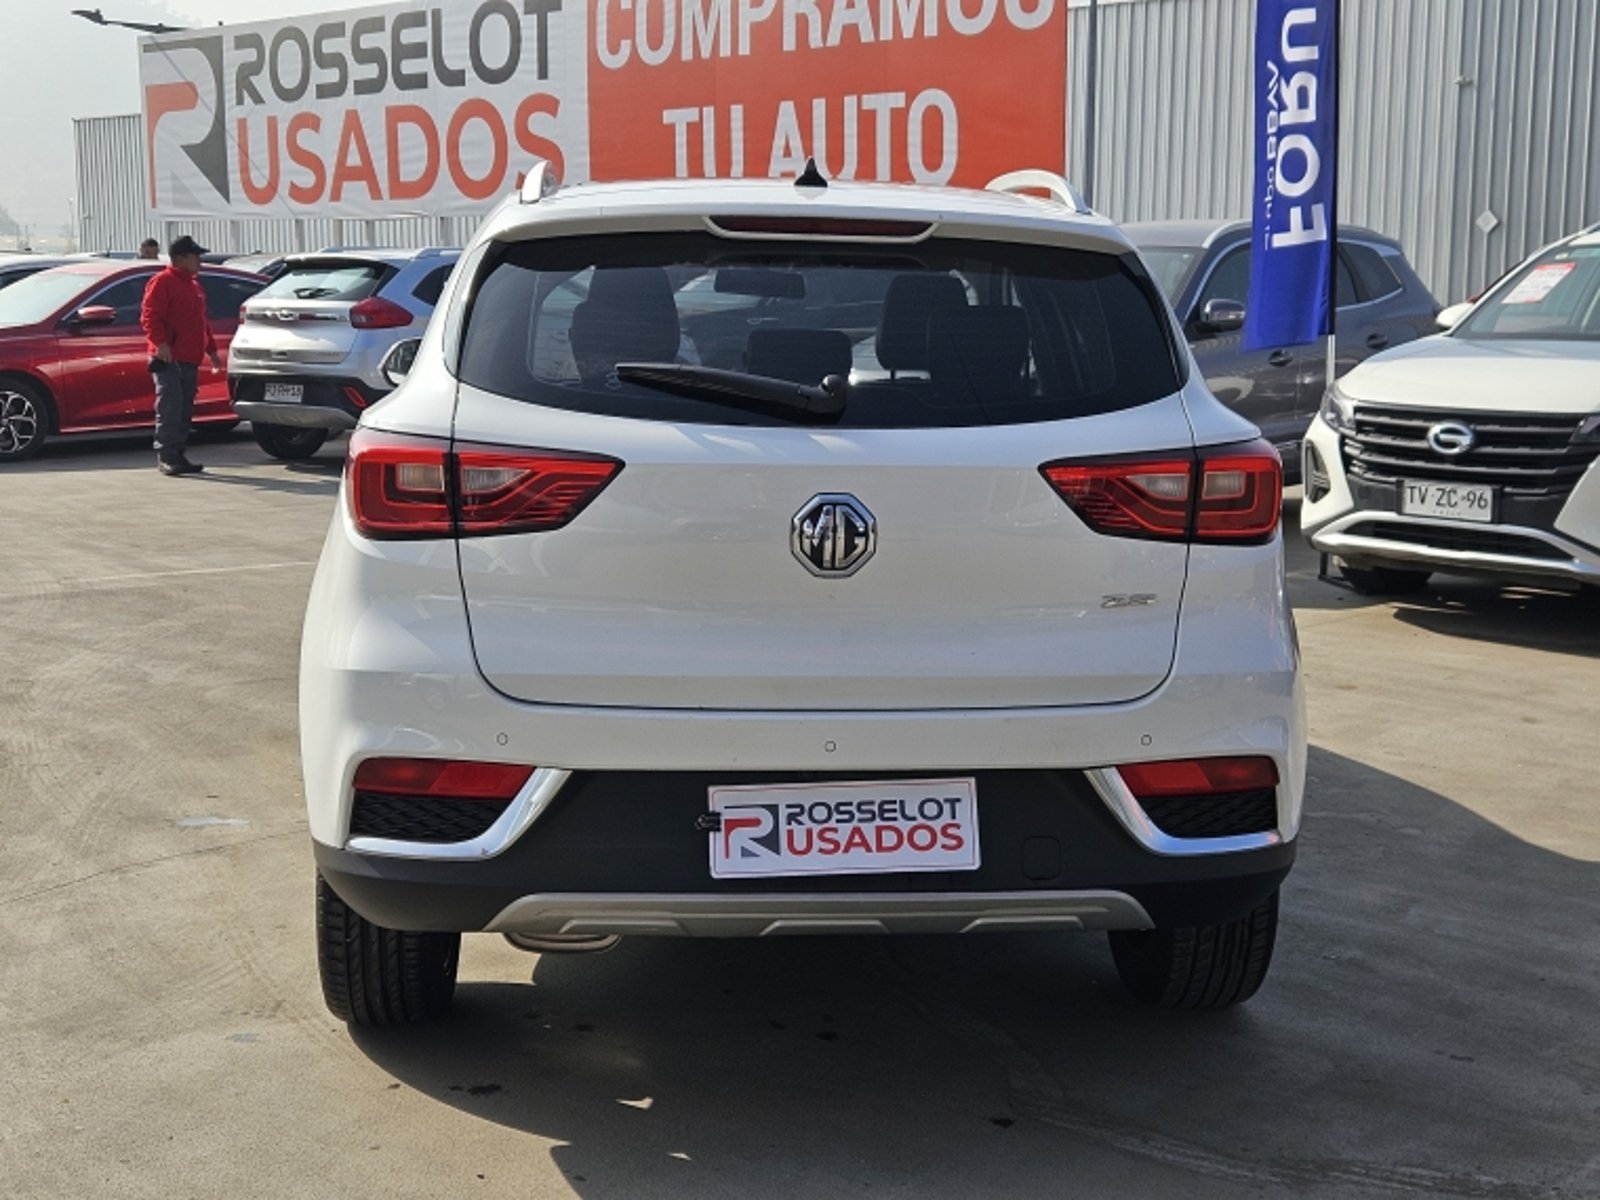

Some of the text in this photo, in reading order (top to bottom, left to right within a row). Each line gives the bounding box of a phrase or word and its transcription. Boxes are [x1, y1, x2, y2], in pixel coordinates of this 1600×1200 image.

[233, 0, 563, 106] ROSSELOT
[237, 92, 566, 206] USADOS
[662, 87, 959, 185] TU AUTO
[797, 501, 870, 573] MG
[785, 797, 963, 826] ROSSELOT
[785, 822, 965, 857] USADOS
